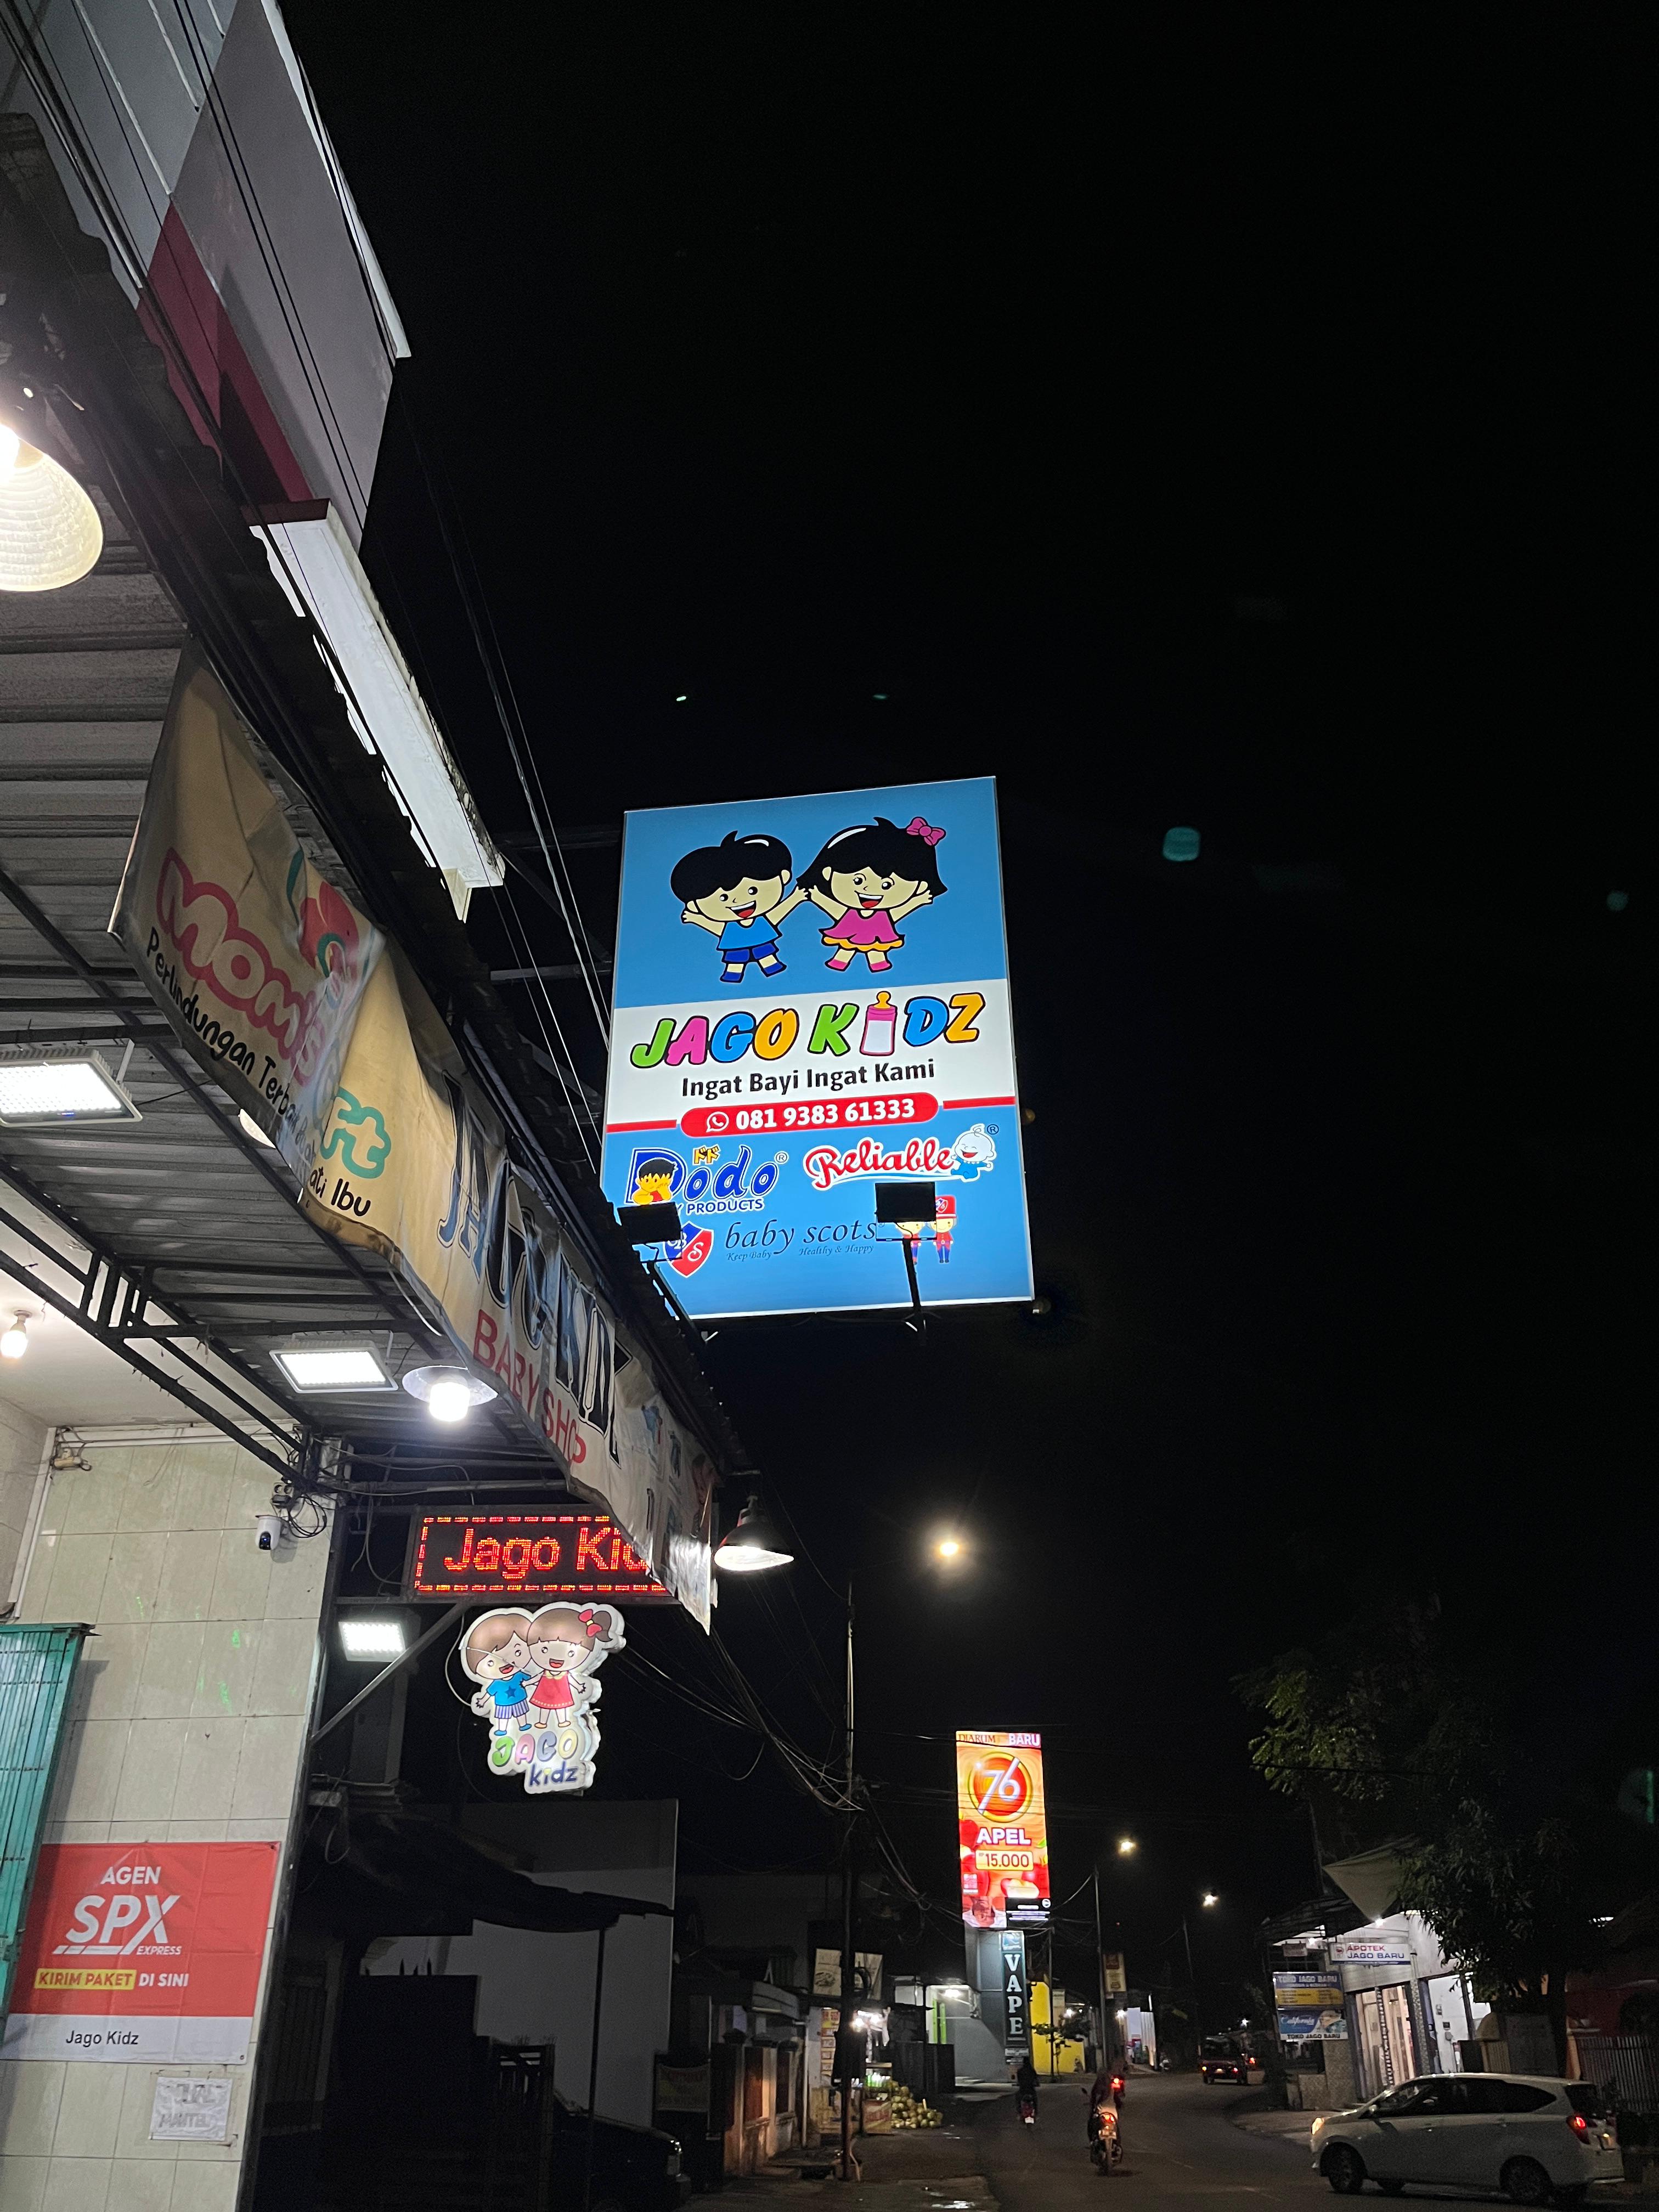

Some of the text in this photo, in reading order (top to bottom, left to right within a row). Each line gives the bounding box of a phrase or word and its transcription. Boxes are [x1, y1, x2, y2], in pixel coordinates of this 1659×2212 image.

[630, 1007, 800, 1069] JAGO
[146, 927, 255, 1077] Perlindungan
[309, 1166, 327, 1198] ati
[331, 1178, 371, 1217] Ibu
[681, 1058, 935, 1101] Ingat Bayi Ingat Kami
[736, 1098, 916, 1130] 081 9383 61333
[625, 1145, 779, 1204] Dodo
[805, 1138, 955, 1189] Reliable
[687, 1199, 764, 1215] PRODUCTS
[725, 1219, 876, 1255] baby scots
[727, 1252, 748, 1262] Keep
[749, 1250, 772, 1261] Baby
[799, 1244, 833, 1256] Healthy
[845, 1244, 874, 1255] Happy
[473, 1308, 540, 1415] BABY
[444, 1527, 561, 1579] Jago
[491, 1729, 578, 1767] JAGO
[1009, 1733, 1040, 1746] BARU
[528, 1760, 579, 1787] kidz
[978, 1757, 1021, 1816] 76
[976, 1827, 1031, 1846] APEL
[101, 1866, 161, 1885] AGEN
[985, 1853, 1029, 1868] 15.000
[65, 1894, 180, 1954] SPX
[136, 1945, 182, 1955] EXPRESS
[38, 1971, 189, 1987] KIRIM PAKET DI SINI
[1005, 1954, 1023, 2035] VAPE
[66, 2030, 139, 2047] Jago Kidz
